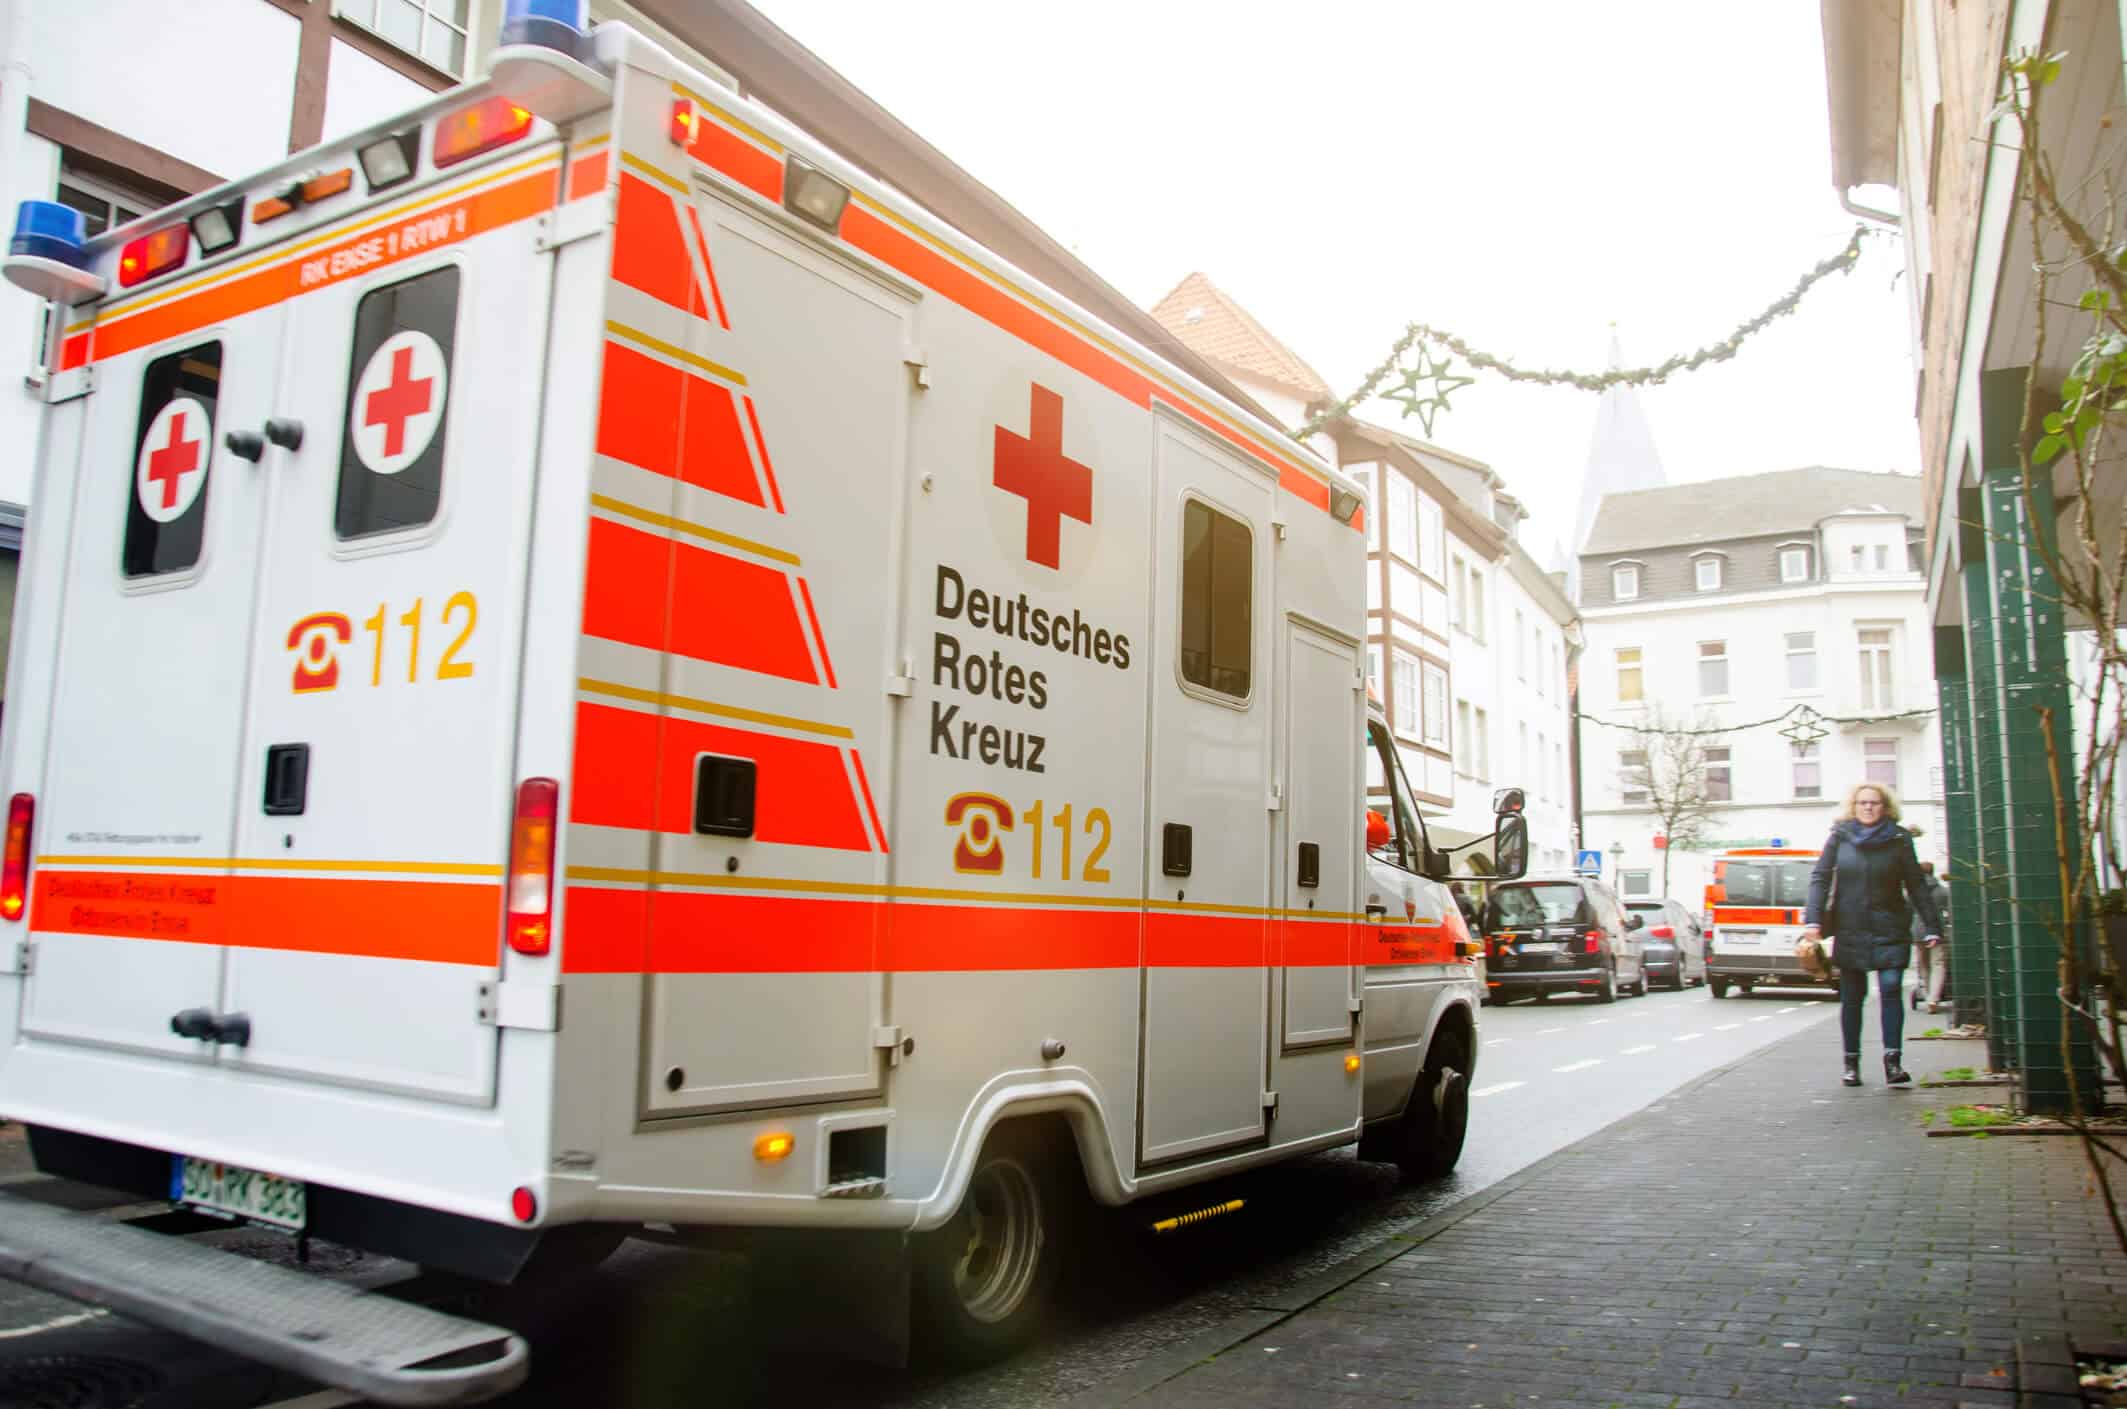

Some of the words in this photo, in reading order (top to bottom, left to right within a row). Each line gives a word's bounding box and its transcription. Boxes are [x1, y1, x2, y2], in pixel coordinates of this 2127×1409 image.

[300, 256, 329, 286] RK
[330, 237, 384, 275] ENSE
[388, 231, 399, 256] 1
[401, 212, 451, 250] RTW
[454, 208, 466, 232] 1
[364, 590, 478, 687] 112
[935, 563, 1131, 670] Deutsches
[933, 631, 1048, 710] Rotes
[929, 700, 1046, 774] Kreuz
[1023, 799, 1112, 884] 112
